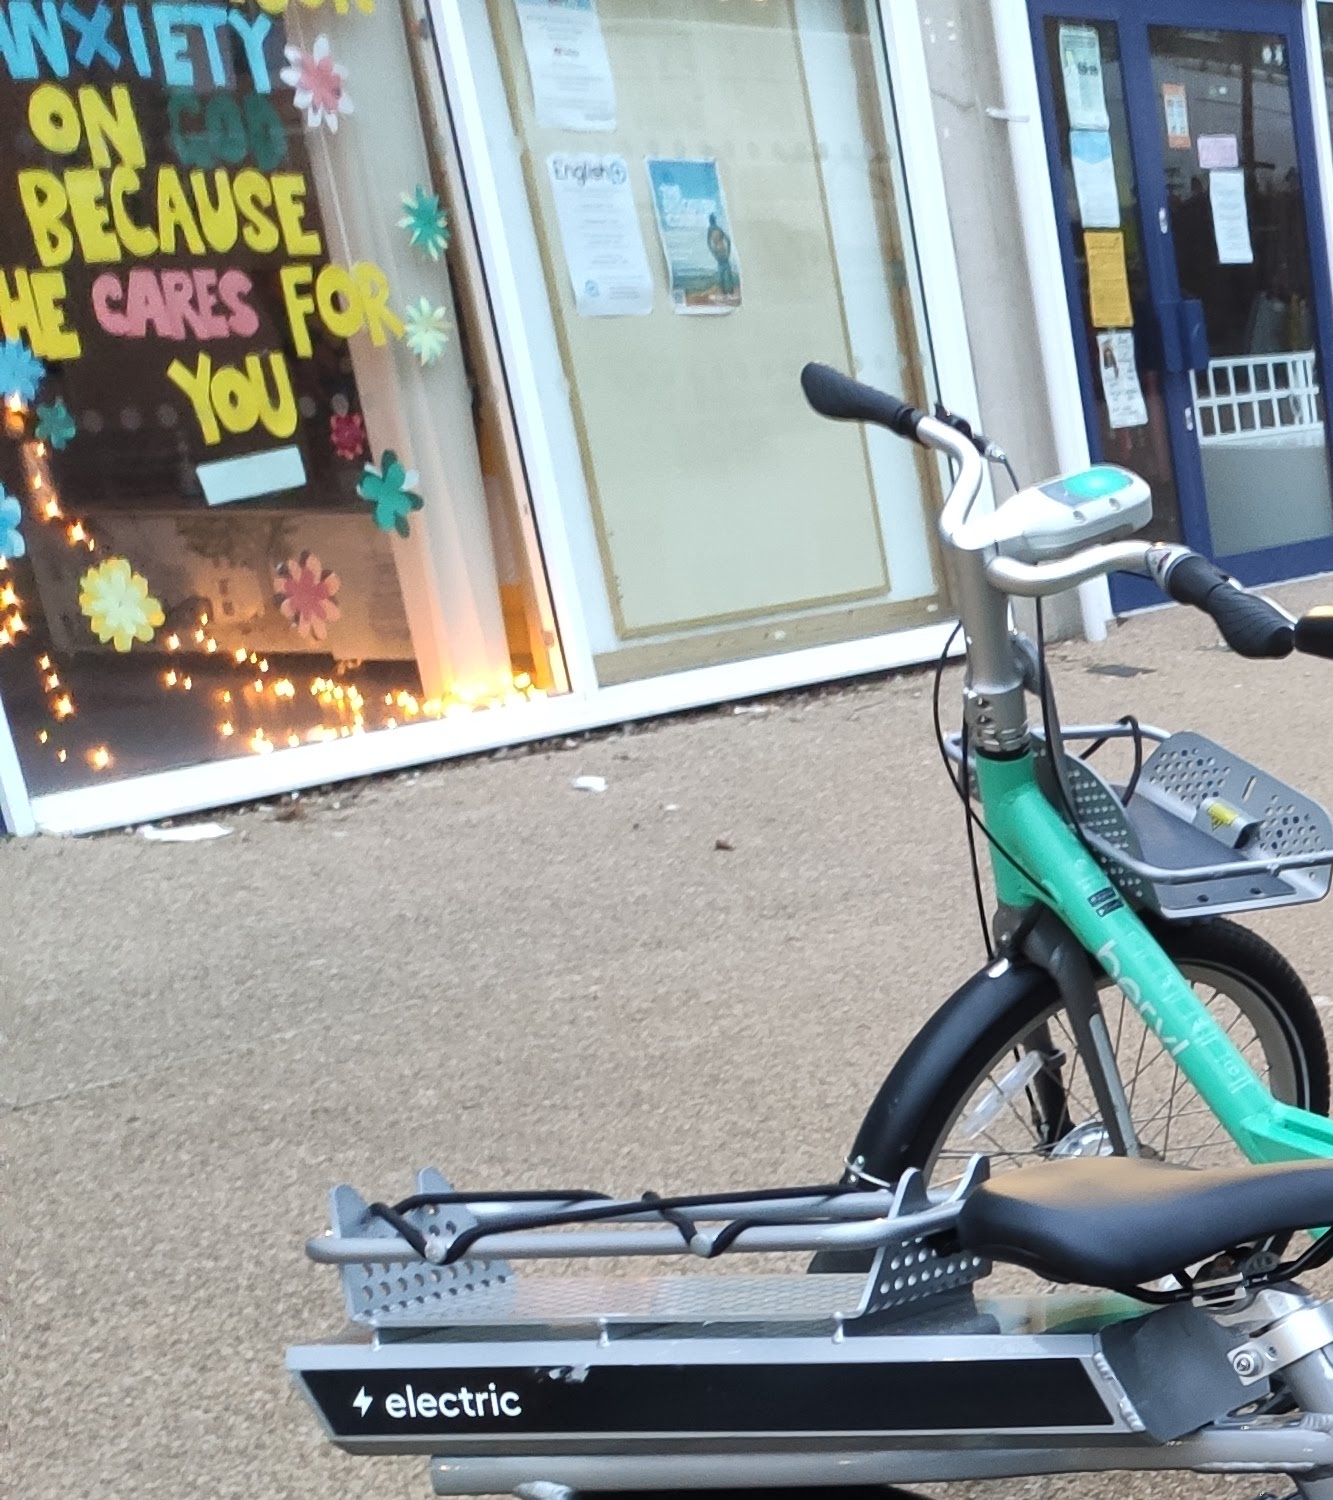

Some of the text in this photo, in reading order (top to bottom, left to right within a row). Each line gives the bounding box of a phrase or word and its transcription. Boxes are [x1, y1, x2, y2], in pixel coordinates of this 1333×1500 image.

[28, 82, 146, 170] ON
[18, 166, 323, 268] BECAUSE
[92, 267, 260, 339] CARES
[280, 262, 404, 358] FOR
[167, 352, 298, 445] YOU
[385, 1382, 522, 1418] electric
